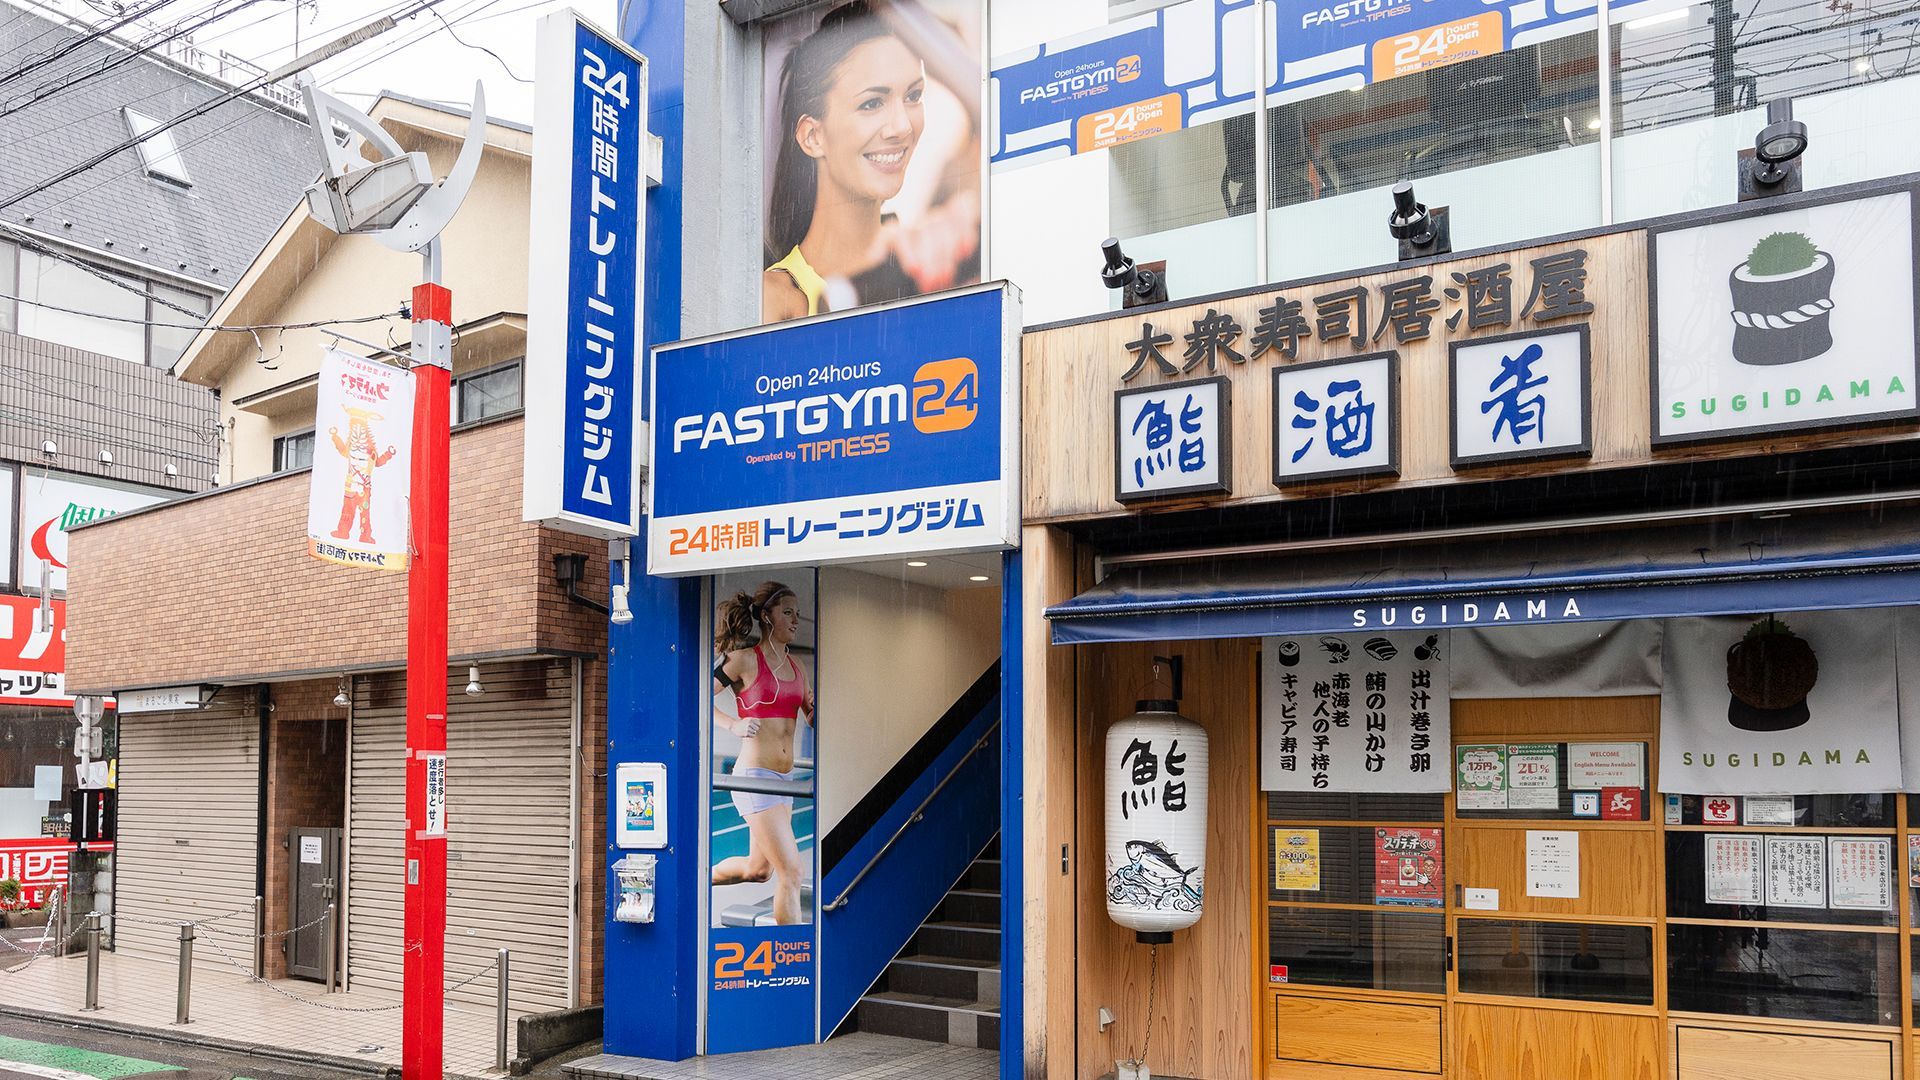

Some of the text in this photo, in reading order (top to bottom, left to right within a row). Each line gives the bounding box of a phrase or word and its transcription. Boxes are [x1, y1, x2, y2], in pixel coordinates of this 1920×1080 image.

[1365, 4, 1412, 23] TIPNESS
[1446, 21, 1479, 35] hours
[1394, 28, 1447, 65] 24
[1446, 30, 1479, 45] Open
[1020, 66, 1115, 105] FASTGYM
[1054, 60, 1105, 80] Open 24hours
[1072, 84, 1109, 100] TIPNESS
[1136, 101, 1163, 112] hours
[1094, 107, 1138, 140] 24
[1136, 109, 1163, 122] Open
[581, 48, 630, 506] 24時間トレーニングジム
[1121, 249, 1594, 382] 大衆寿司居酒屋
[756, 361, 881, 396] Open 24hours
[1481, 343, 1549, 444] 肴
[1672, 376, 1905, 418] SUGIDAMA
[673, 373, 978, 453] FASTGYM 24
[1292, 379, 1375, 463] 酒
[746, 433, 890, 464] Operated by TIPNESS
[1132, 394, 1206, 488] 鮨
[670, 498, 985, 555] 24時間トレーニングジム
[1353, 598, 1581, 627] SUGIDAMA
[1331, 672, 1350, 728] 赤海老
[1280, 672, 1297, 772] キャビア寿司
[1311, 681, 1330, 789] 他人の子持ち
[1365, 671, 1387, 772] 鮪の山かけ
[1409, 669, 1431, 773] 出汁巻き卵
[1683, 749, 1871, 768] SUGIDAMA
[1121, 738, 1187, 820] 鮨
[715, 940, 776, 979] 24
[775, 940, 810, 951] hours
[775, 951, 810, 965] Open
